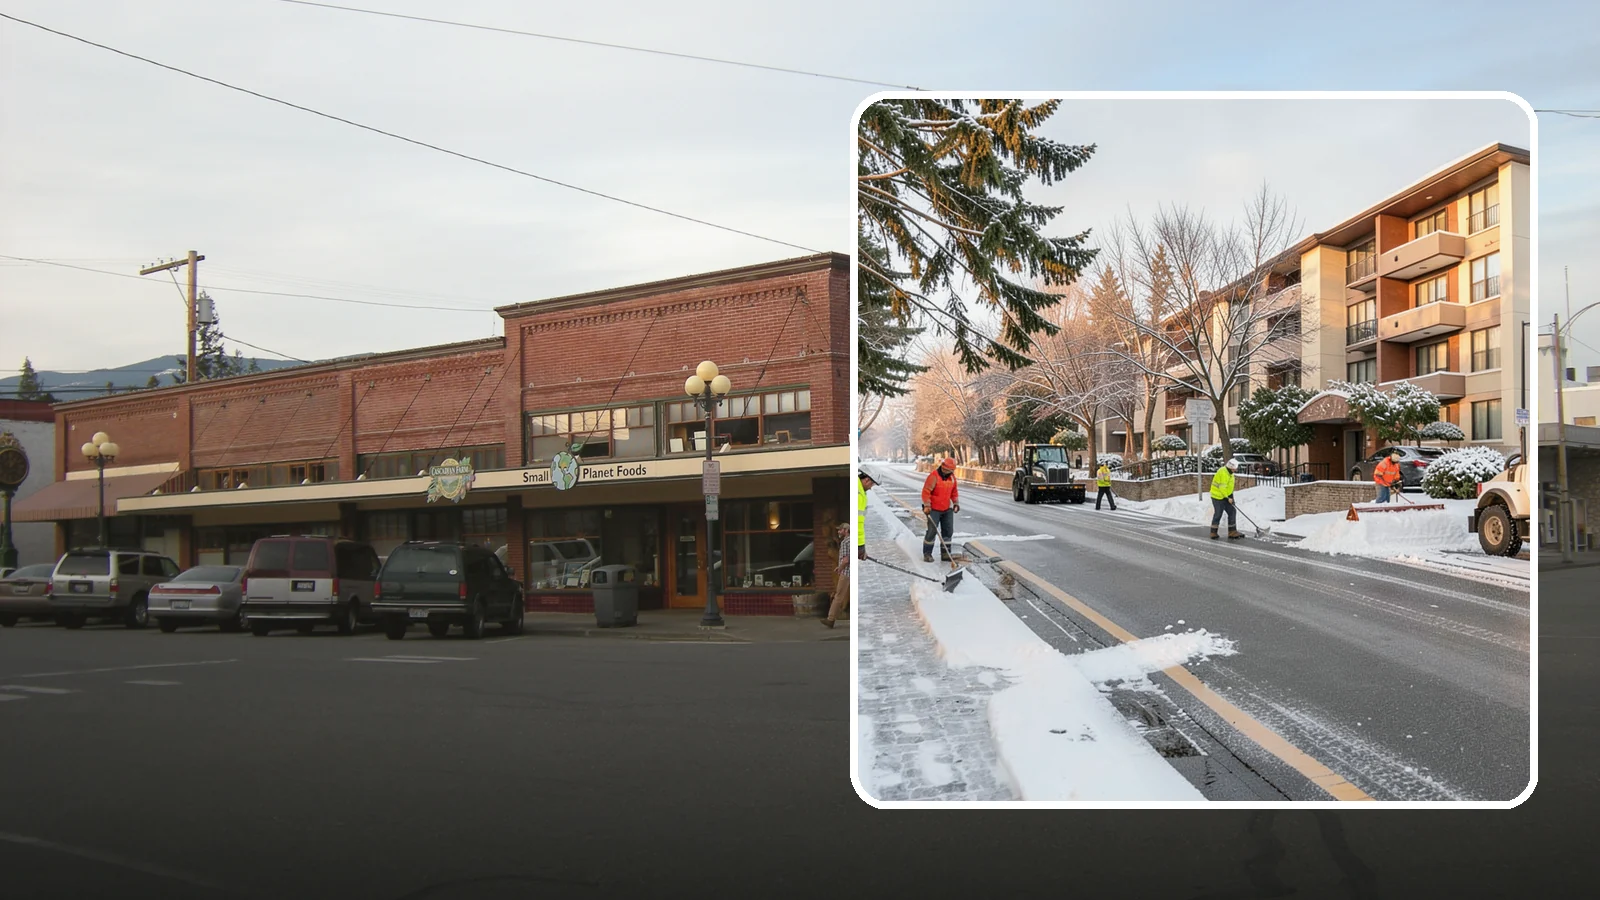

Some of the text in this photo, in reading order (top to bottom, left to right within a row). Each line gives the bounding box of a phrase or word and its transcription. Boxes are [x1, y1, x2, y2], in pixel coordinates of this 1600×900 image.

[523, 464, 647, 483] Small Planet Foods
